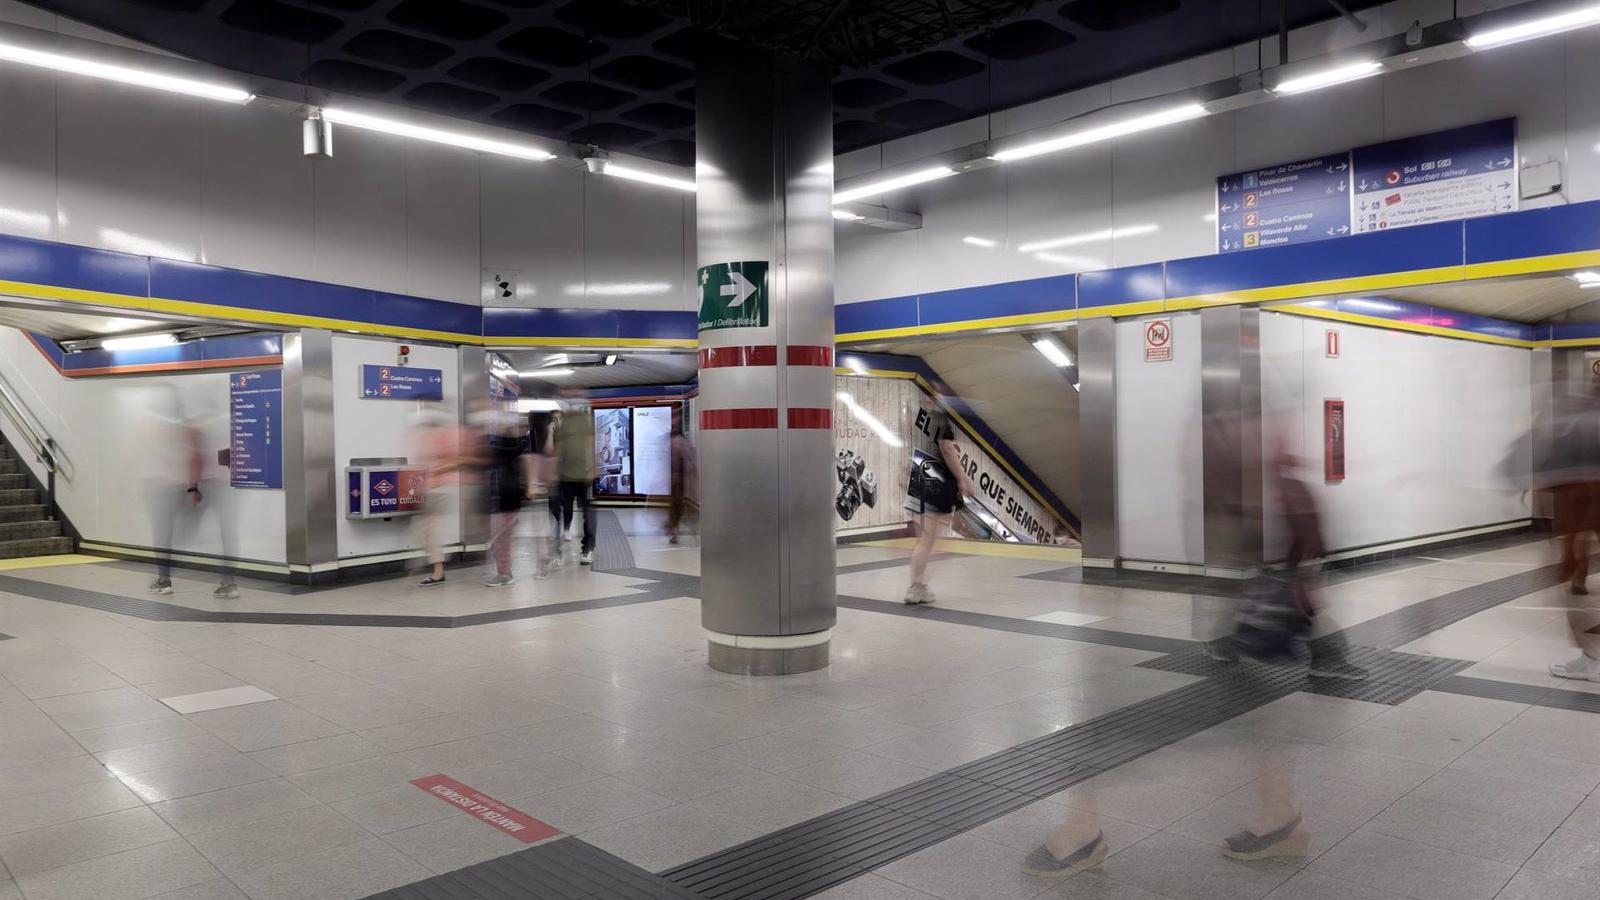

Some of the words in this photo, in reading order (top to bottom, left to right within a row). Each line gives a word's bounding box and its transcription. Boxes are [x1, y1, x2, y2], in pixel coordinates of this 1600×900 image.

[1404, 166, 1418, 174] Sol
[1247, 176, 1254, 186] 1
[1404, 172, 1440, 184] Suburban
[1440, 168, 1468, 179] railway
[1272, 186, 1294, 195] Rosas
[1246, 194, 1256, 206] 2
[1246, 214, 1256, 226] 2
[1260, 218, 1282, 226] Cuatro
[1282, 212, 1313, 223] Caminos
[1260, 226, 1292, 236] Villaverde
[1293, 224, 1308, 232] Alto
[1247, 234, 1256, 245] 3
[382, 370, 388, 378] 2
[382, 386, 388, 394] 2
[915, 407, 931, 438] EL
[980, 472, 1006, 506] QUE
[1006, 497, 1052, 544] SIEMPRE
[380, 498, 396, 506] TUYO
